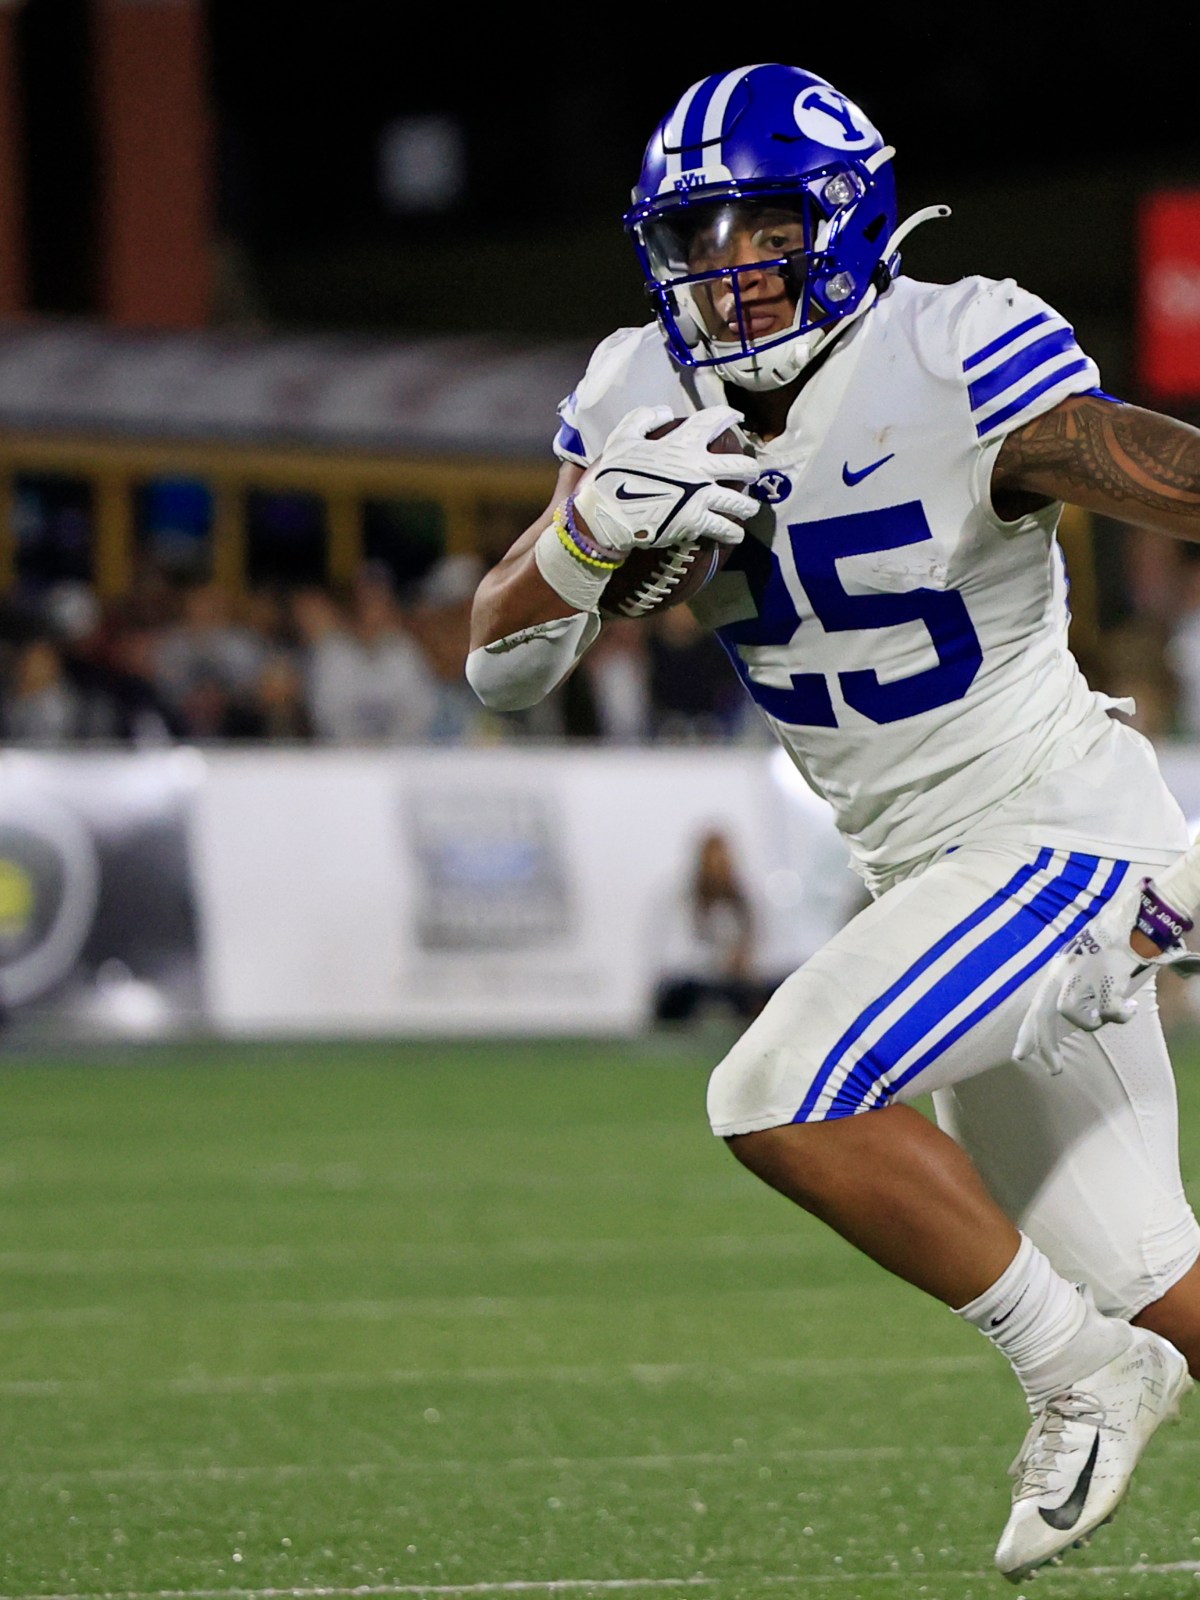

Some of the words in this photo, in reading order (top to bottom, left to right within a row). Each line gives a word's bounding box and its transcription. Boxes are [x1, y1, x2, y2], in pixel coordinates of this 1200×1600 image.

[801, 91, 864, 142] Y
[756, 474, 785, 499] Y
[713, 499, 984, 728] 25
